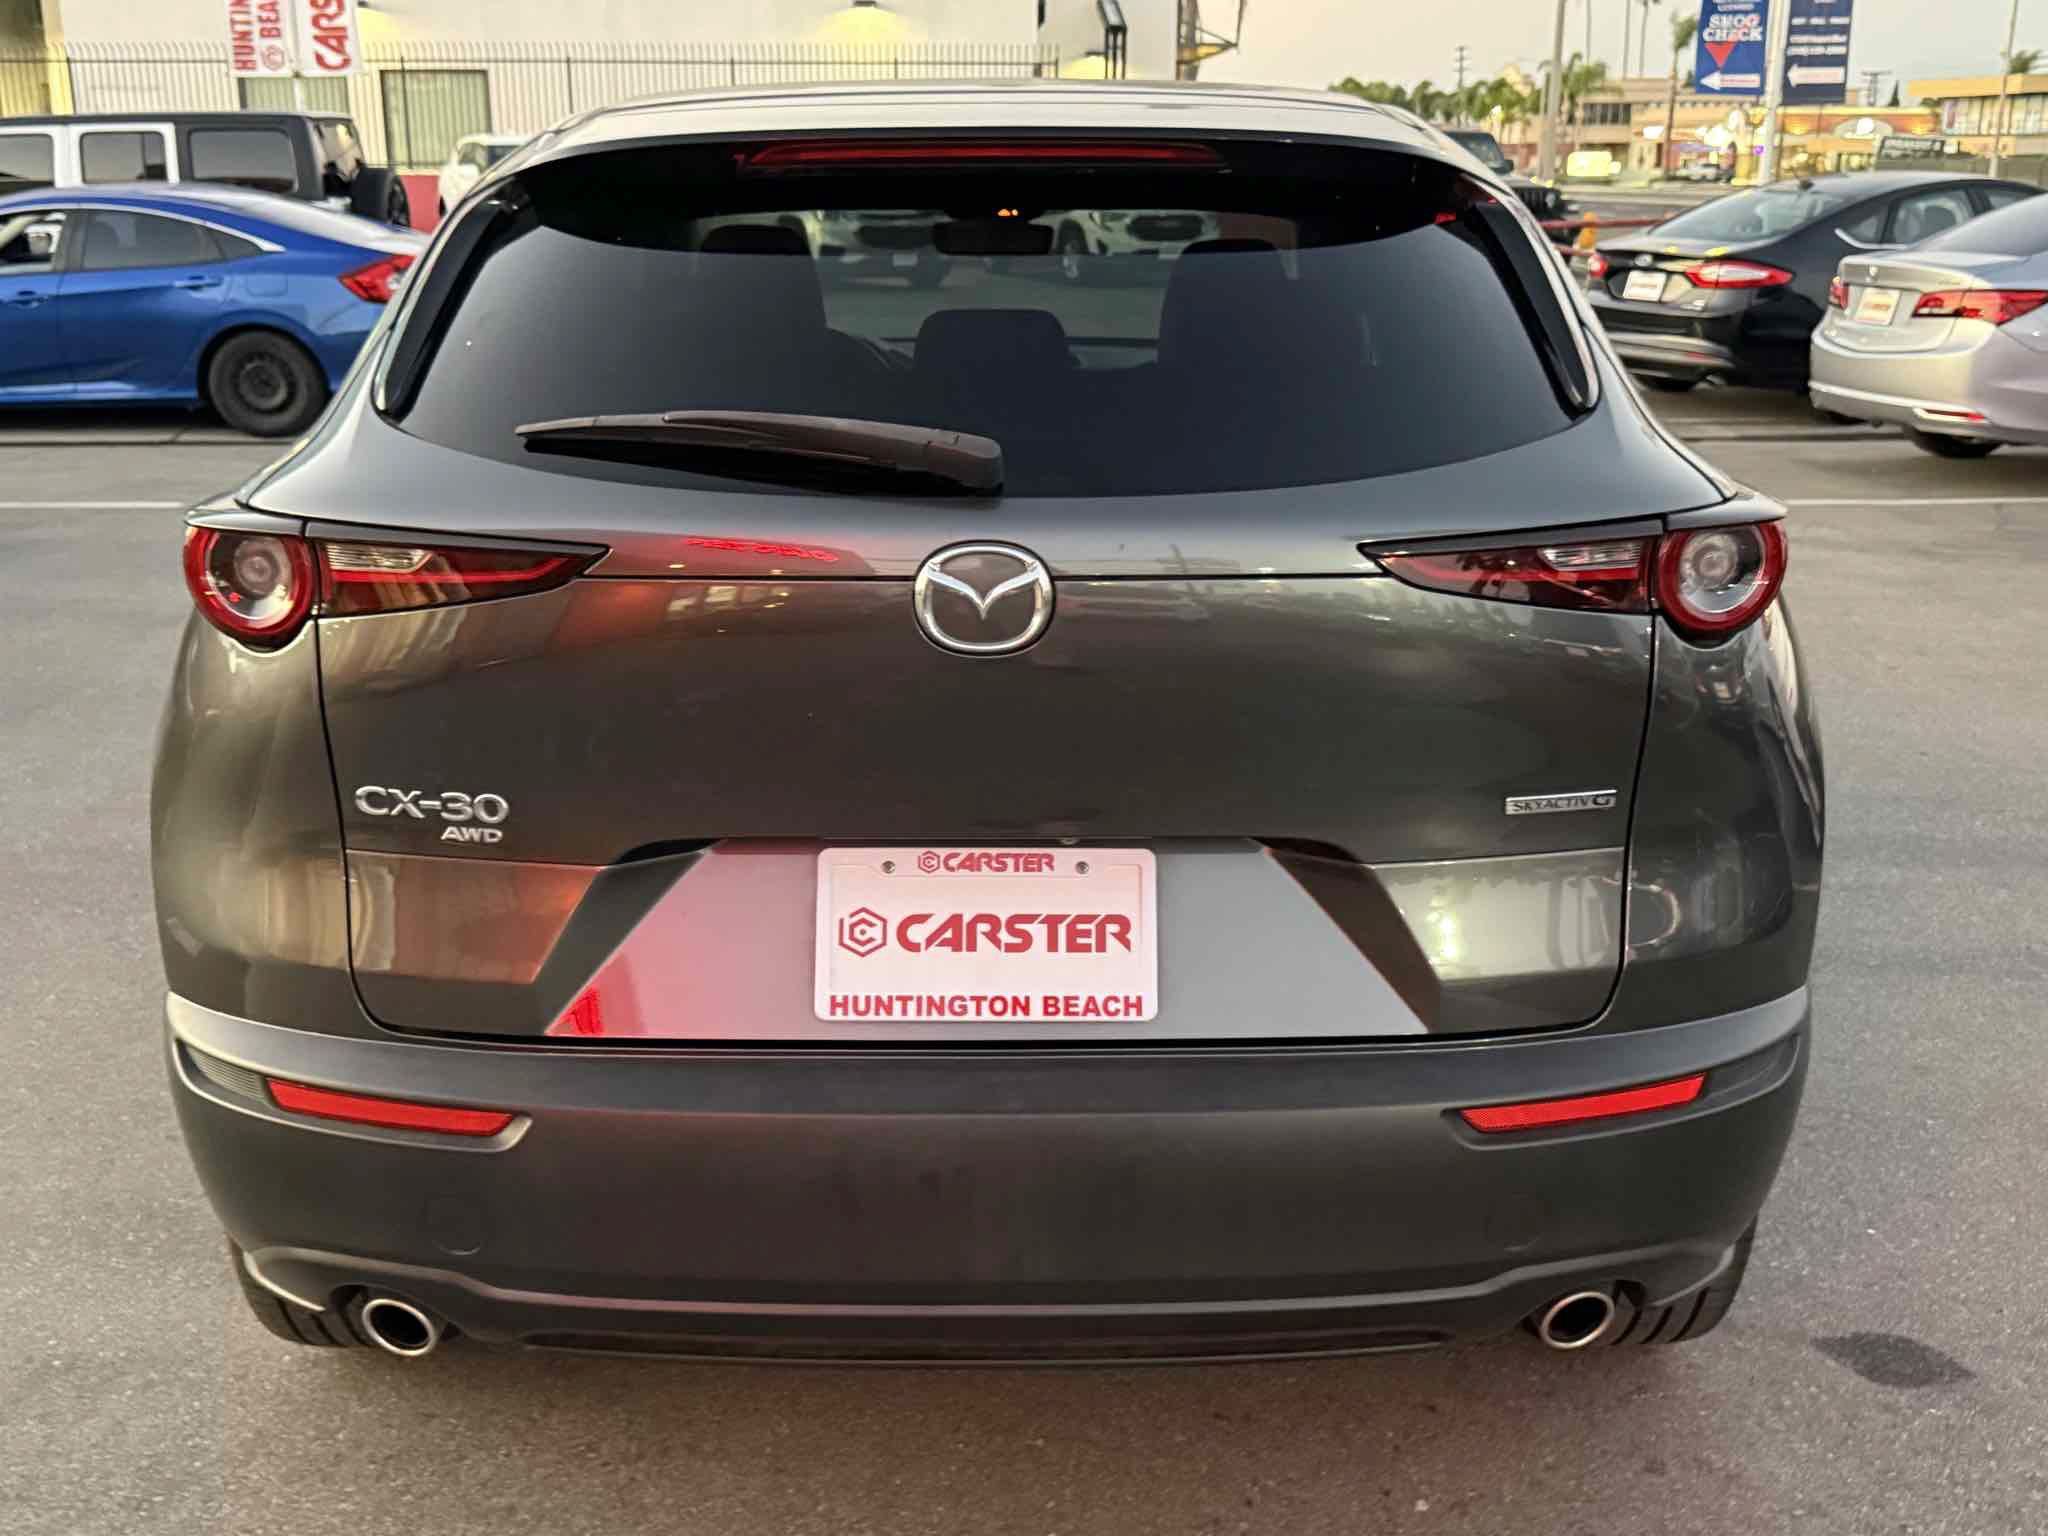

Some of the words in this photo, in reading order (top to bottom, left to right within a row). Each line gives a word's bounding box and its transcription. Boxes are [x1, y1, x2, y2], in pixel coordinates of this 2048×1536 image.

[1709, 13, 1760, 29] SMOG
[1703, 27, 1762, 42] CHECK
[355, 785, 509, 824] CX-30
[440, 826, 503, 842] AWD
[943, 852, 1054, 873] CARSTER
[896, 913, 1131, 953] CARSTER
[830, 995, 1030, 1016] HUNTINGTON
[1043, 995, 1142, 1016] BEACH
